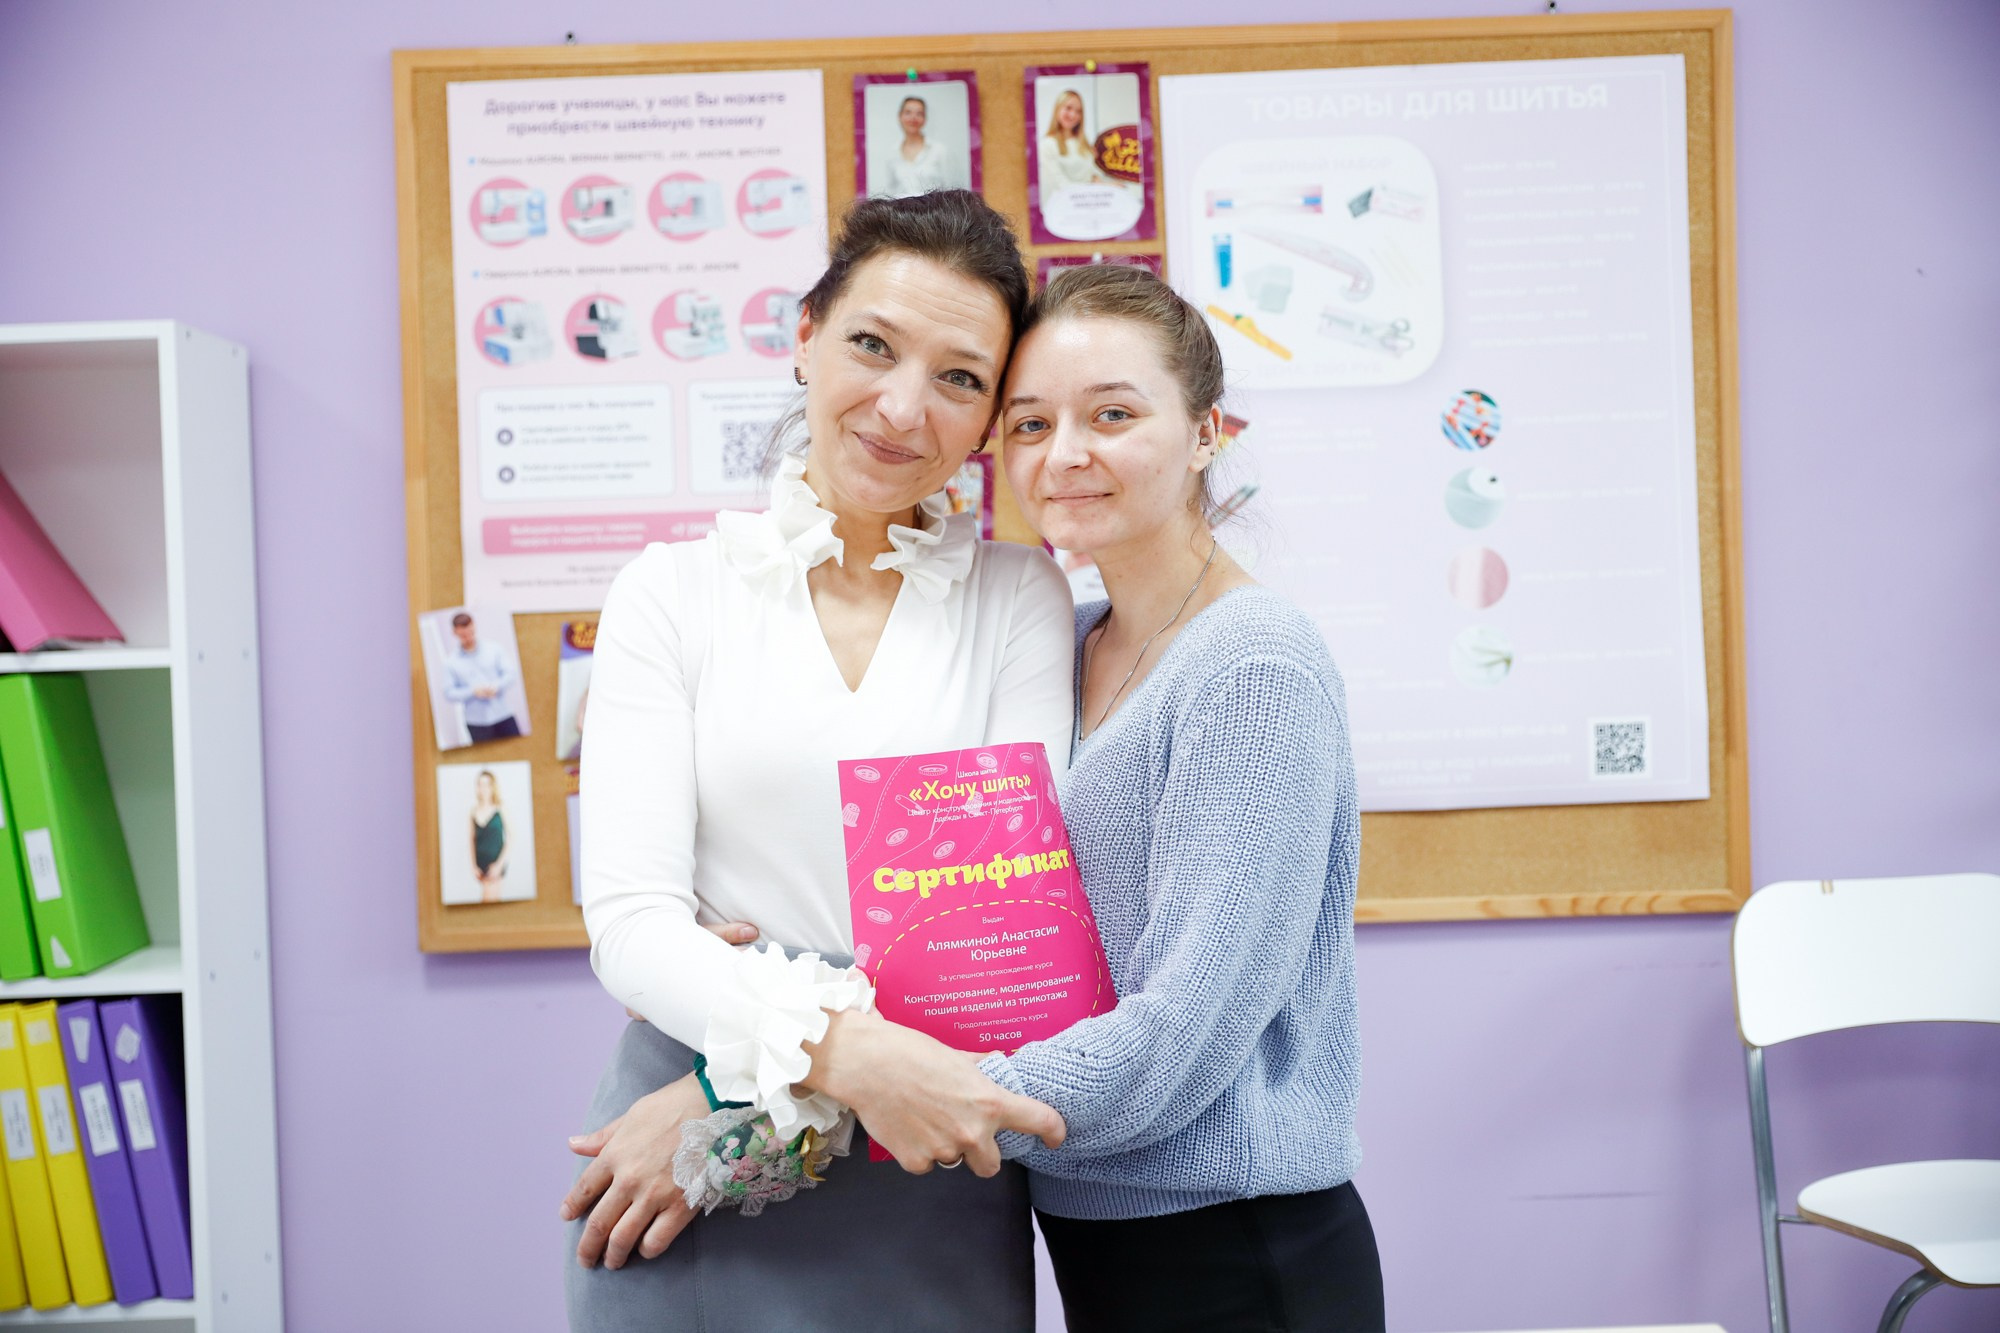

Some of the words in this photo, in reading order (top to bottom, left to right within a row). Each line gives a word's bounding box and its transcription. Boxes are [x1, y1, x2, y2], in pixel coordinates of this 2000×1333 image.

[1245, 93, 1393, 124] ТОВАРЫ
[1402, 87, 1477, 120] ДЛЯ
[1486, 82, 1610, 114] ШИТЬЯ
[957, 770, 979, 779] Школа
[980, 768, 998, 777] шитья
[908, 779, 978, 802] «Хочу
[982, 774, 1032, 794] шить»
[907, 808, 931, 817] Центр
[934, 814, 962, 823] одежды
[873, 849, 1070, 898] Сертификат
[982, 916, 1005, 924] Выдан
[926, 933, 999, 952] Алямкиной
[1001, 925, 1060, 943] Анастасии
[970, 945, 1027, 962] Юрьевне
[938, 974, 948, 982] За
[948, 971, 985, 982] успешное
[986, 964, 1034, 977] прохождение
[1034, 961, 1053, 970] курса
[904, 988, 998, 1005] Конструирование,
[1000, 975, 1074, 994] моделирование
[1075, 973, 1081, 981] и
[924, 1006, 959, 1017] пошив
[960, 999, 1003, 1013] изделий
[1005, 998, 1017, 1008] из
[1018, 990, 1068, 1007] трикотажа
[953, 1015, 1028, 1030] Продолжительность
[1028, 1012, 1048, 1022] курса
[979, 1033, 991, 1043] 50
[993, 1030, 1022, 1041] часов
